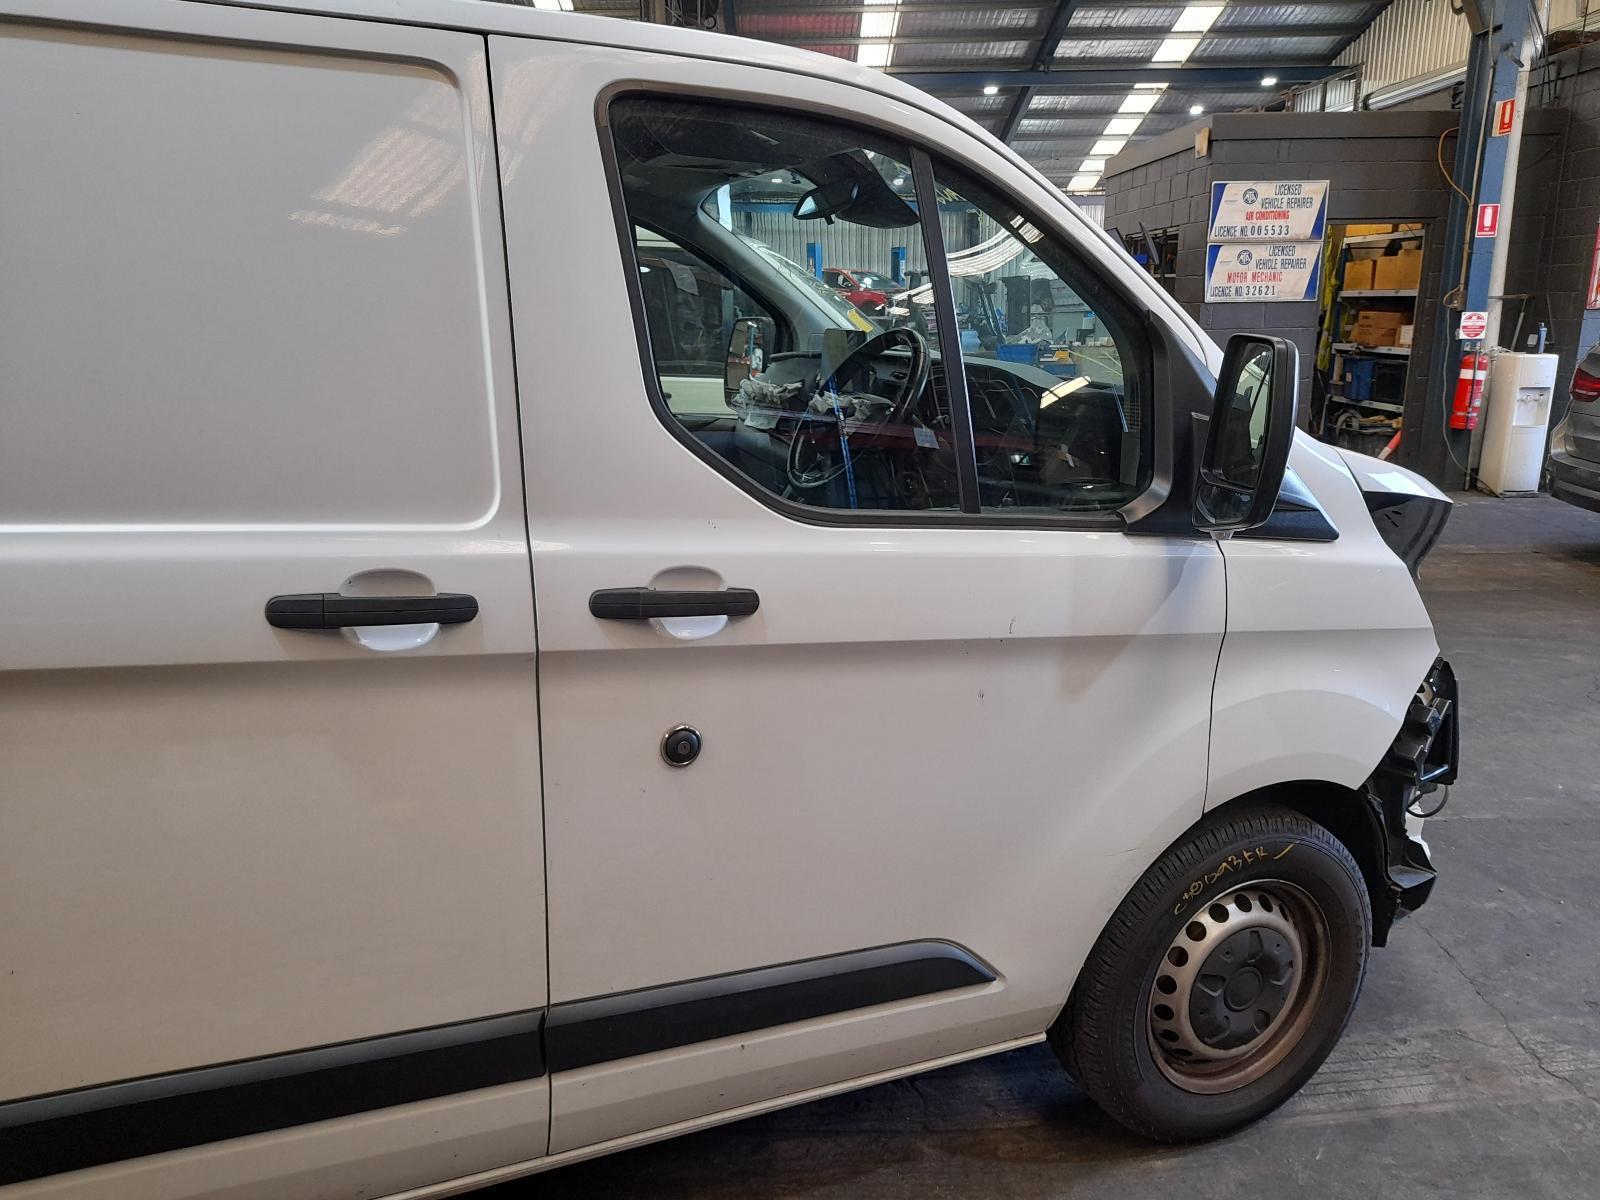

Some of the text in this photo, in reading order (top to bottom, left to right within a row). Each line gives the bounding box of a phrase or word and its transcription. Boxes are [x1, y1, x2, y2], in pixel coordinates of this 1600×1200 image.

[1274, 184, 1302, 196] LICENSED
[1261, 197, 1314, 209] VEHICLE REPAIRER
[1246, 210, 1290, 221] AIR CONDITIONING
[1214, 226, 1237, 238] LICENCE
[1268, 245, 1296, 257] LICENSED
[1256, 258, 1307, 270] VEHICLE REPAIRER
[1227, 271, 1283, 283] MOTOR MECHANIC
[1210, 286, 1232, 297] LICENCE
[1245, 285, 1276, 296] 32621
